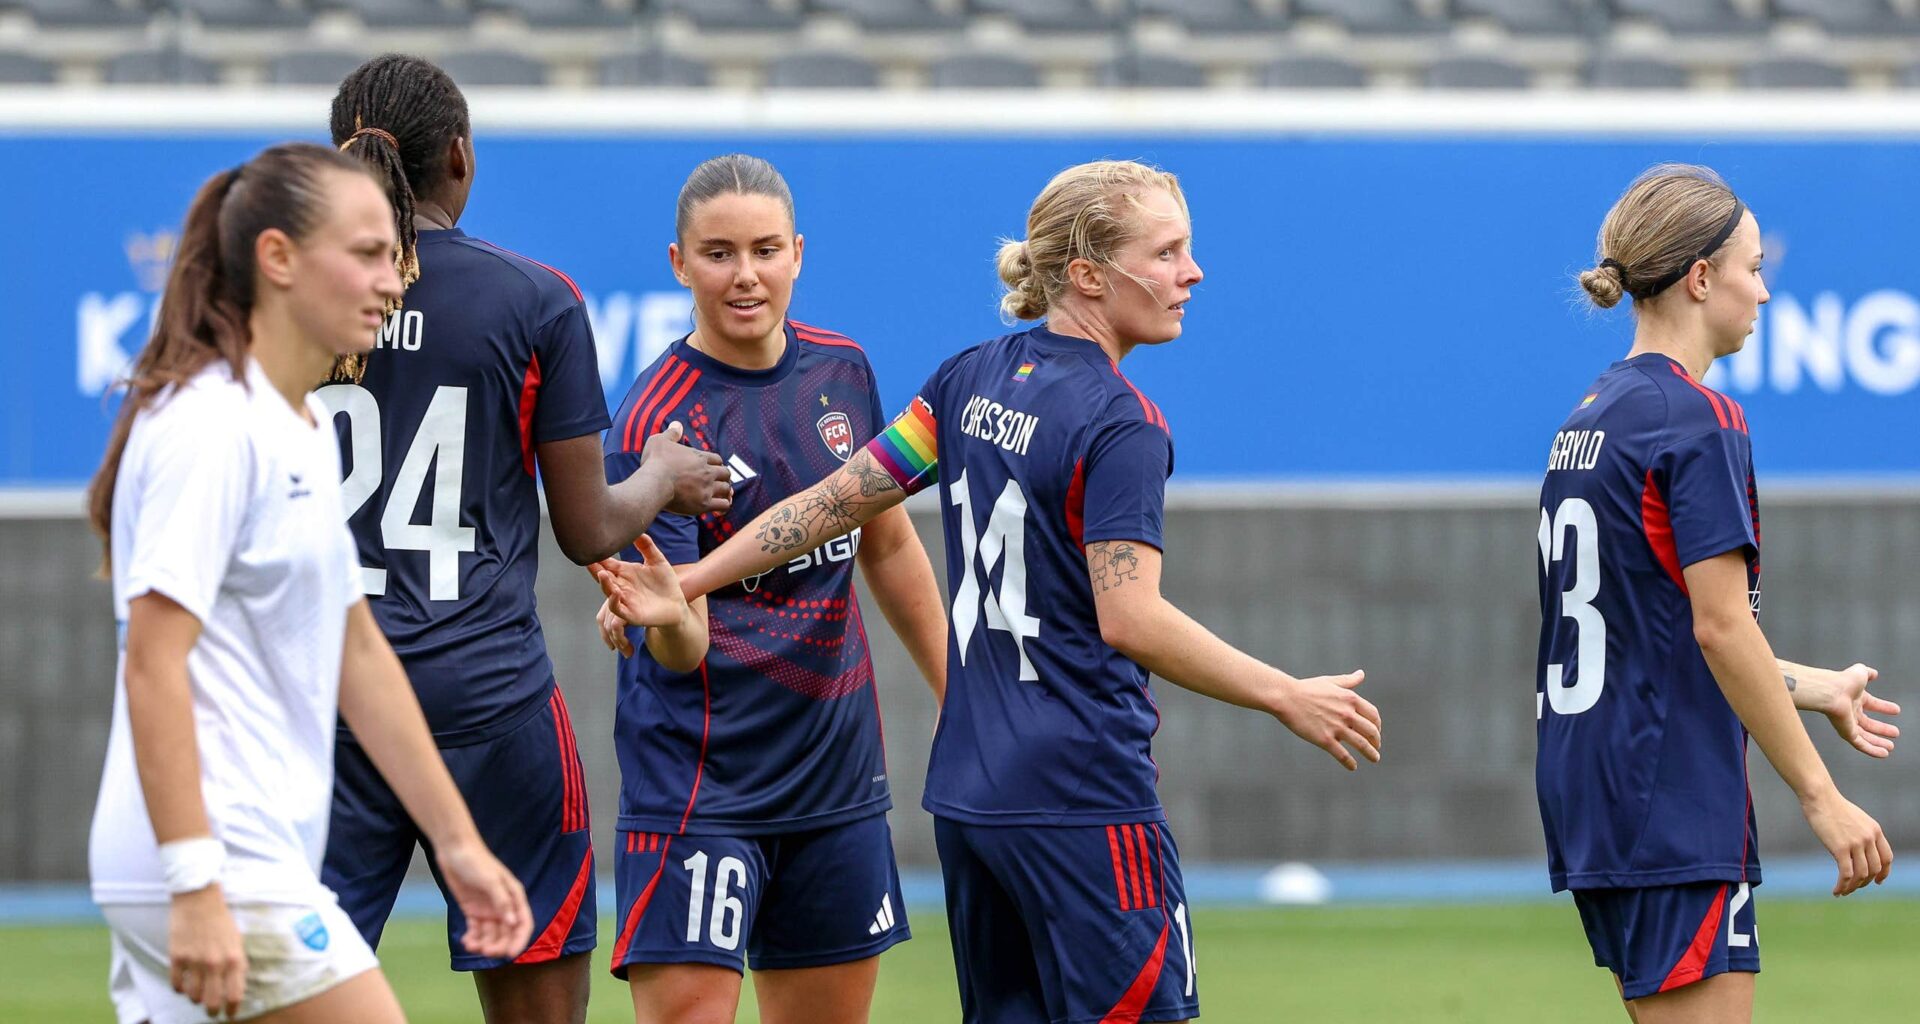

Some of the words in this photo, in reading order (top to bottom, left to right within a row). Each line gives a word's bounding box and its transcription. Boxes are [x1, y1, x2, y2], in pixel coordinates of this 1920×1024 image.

[370, 310, 424, 351] MO
[1702, 290, 1920, 394] ING
[825, 423, 848, 441] FCR
[1545, 430, 1606, 471] GAYLO
[313, 384, 476, 601] 24
[950, 467, 1041, 681] 14
[683, 850, 747, 951] 16
[1727, 882, 1759, 948] 2
[1174, 902, 1197, 996] 1
